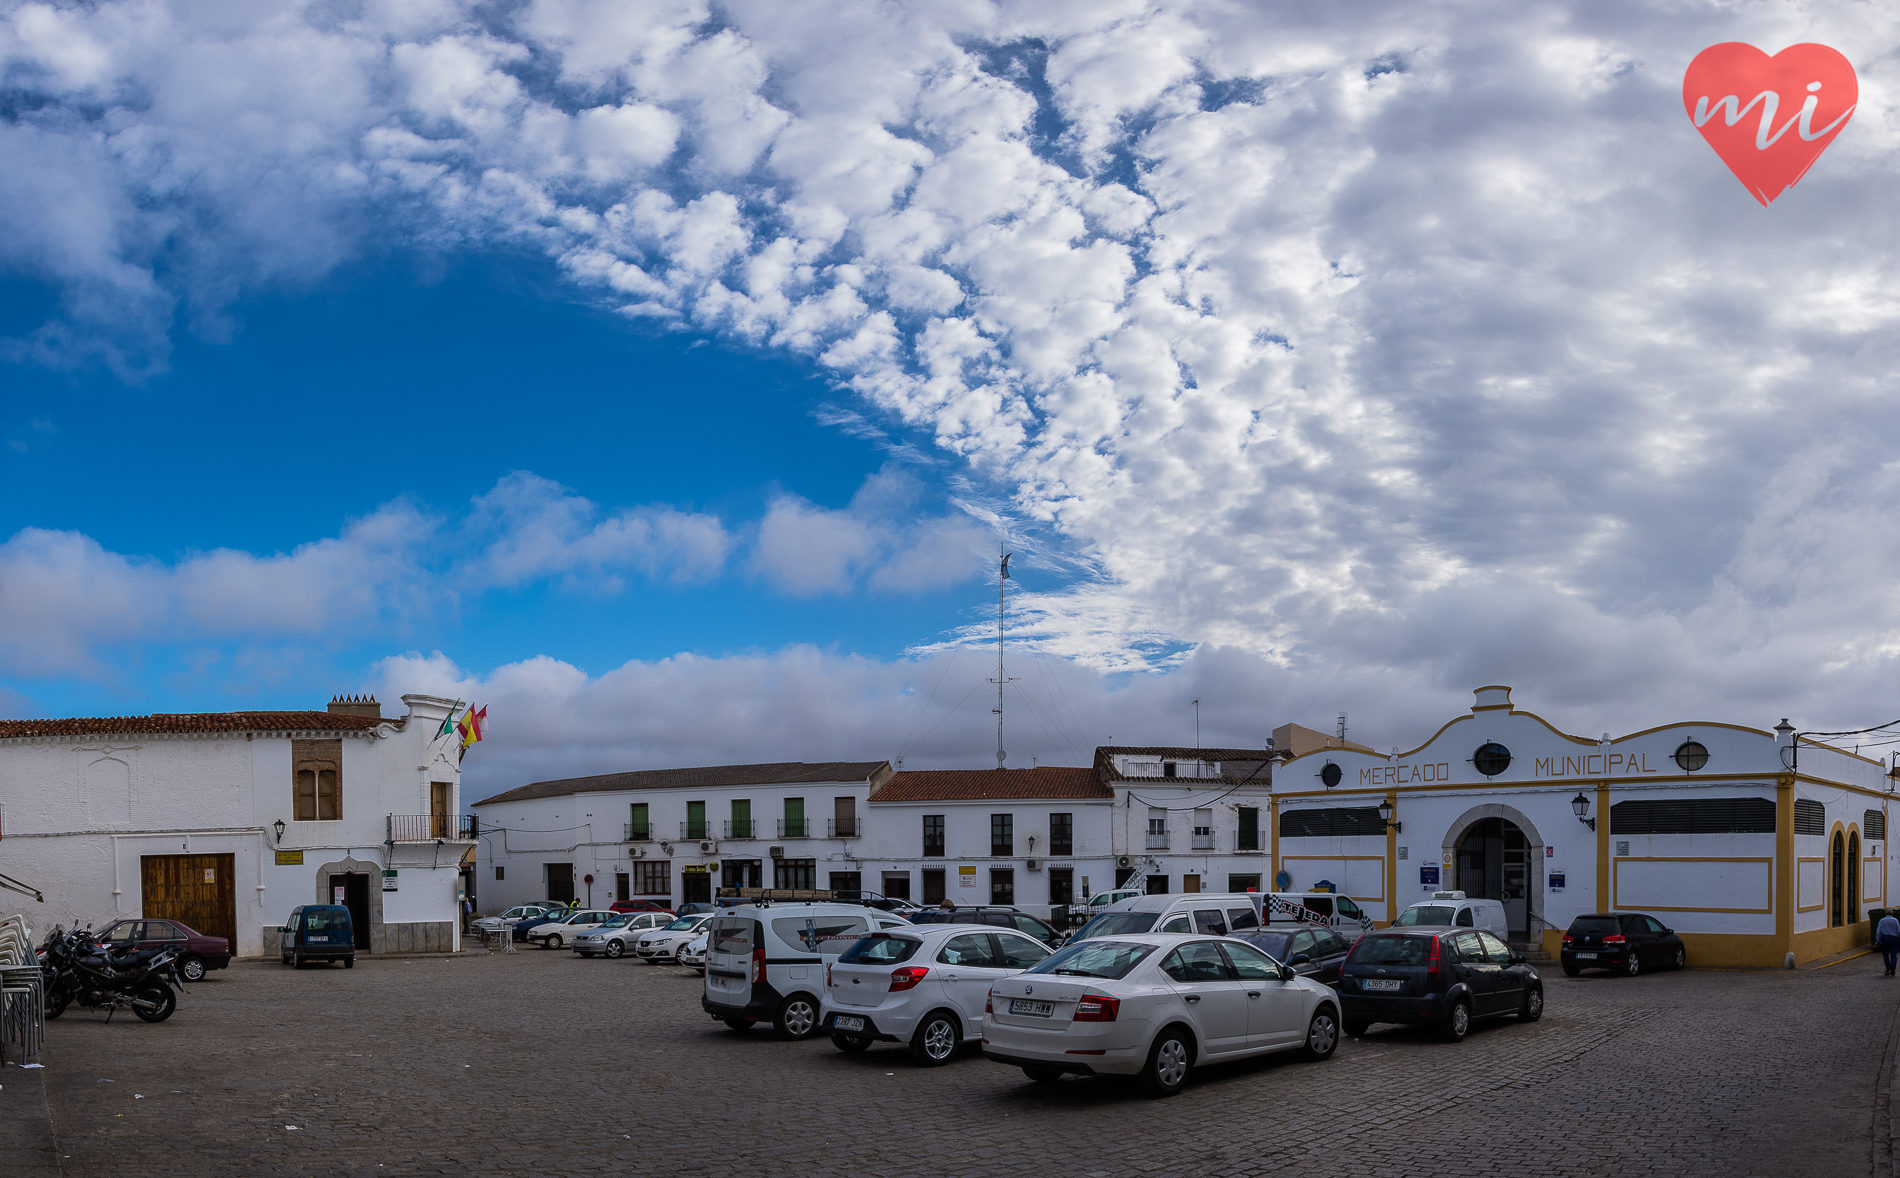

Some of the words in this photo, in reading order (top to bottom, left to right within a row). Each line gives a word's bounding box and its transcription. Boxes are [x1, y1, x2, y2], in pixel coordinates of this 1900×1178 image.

[1360, 762, 1449, 785] MERCADO
[1535, 752, 1657, 777] MUNICIPAL
[1283, 902, 1329, 927] TEJEDA
[1366, 980, 1383, 988] 4365
[1385, 980, 1398, 988] DHY
[1014, 1000, 1033, 1012] 5853
[1035, 1002, 1052, 1013] HWW
[836, 1016, 851, 1026] 2287
[851, 1018, 863, 1028] JZN
